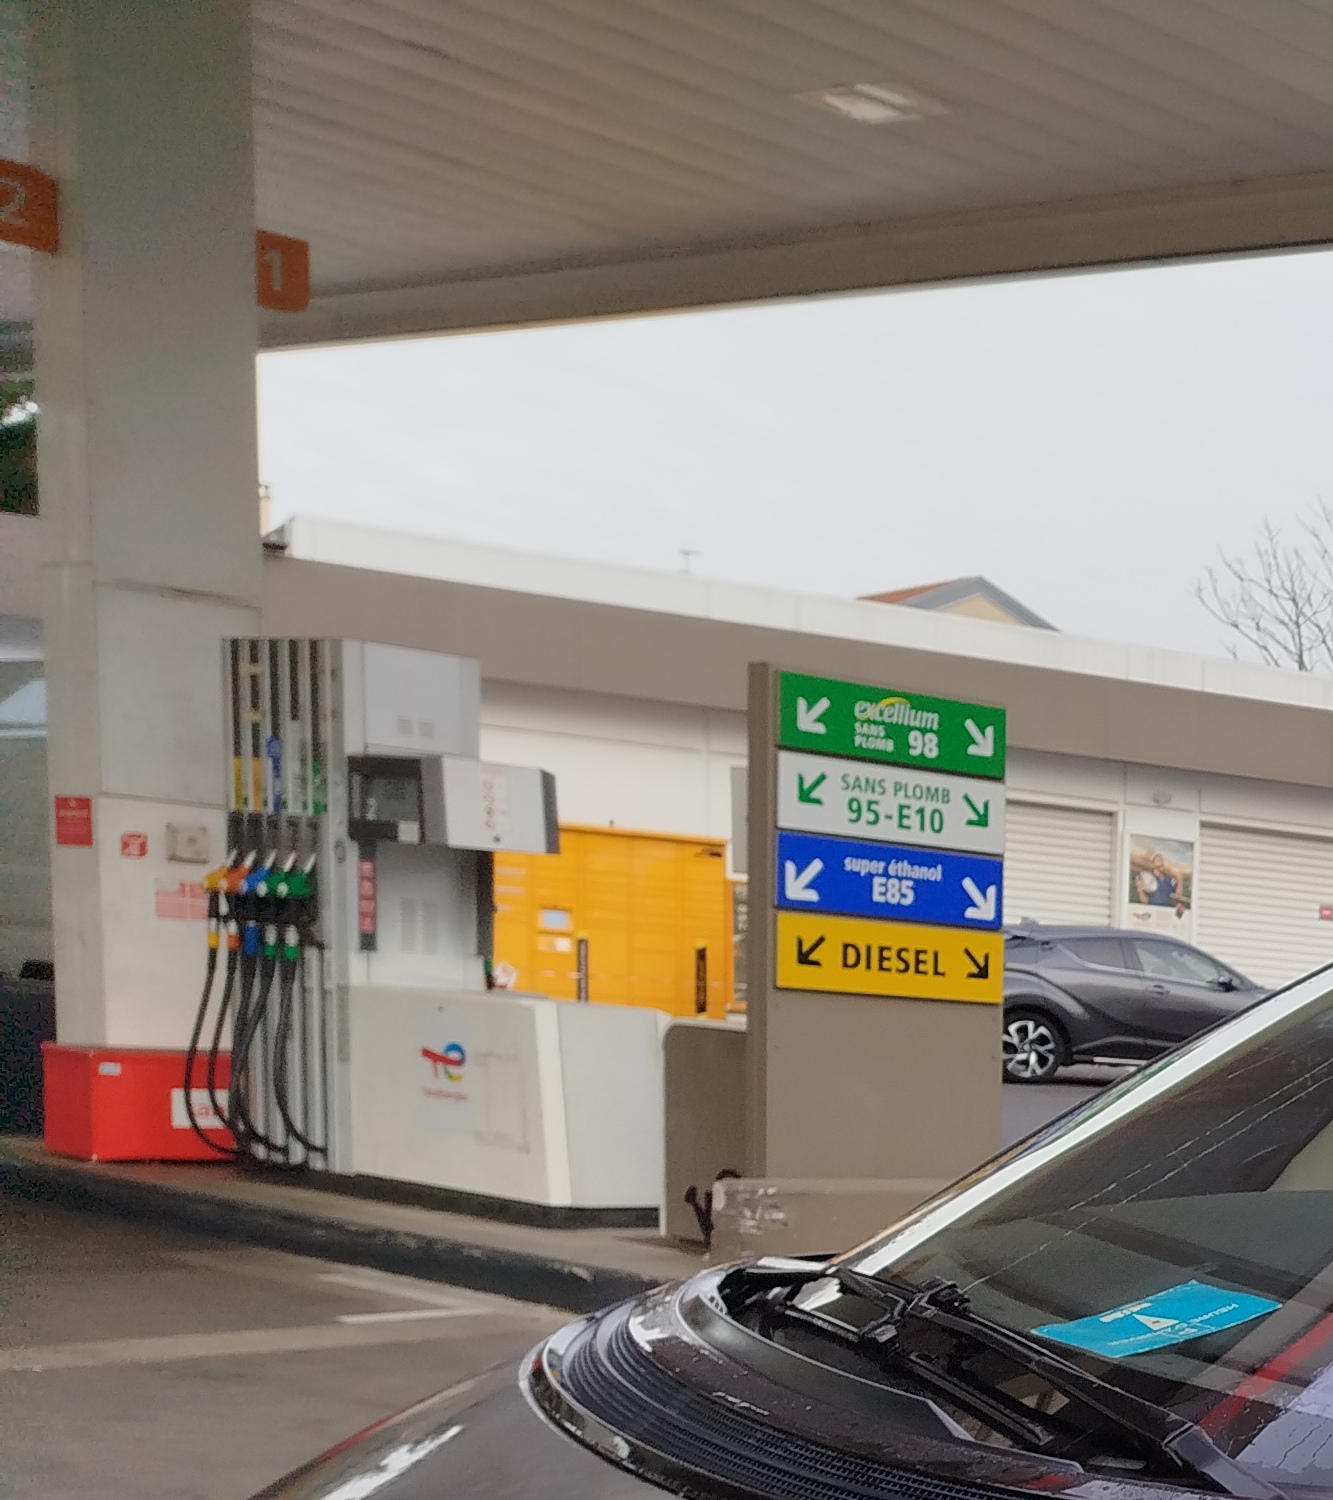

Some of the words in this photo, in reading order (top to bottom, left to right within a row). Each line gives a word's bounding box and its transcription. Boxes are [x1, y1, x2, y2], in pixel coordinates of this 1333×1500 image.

[0, 177, 26, 226] 2
[264, 250, 283, 291] 1
[854, 700, 939, 731] excellium
[854, 721, 886, 738] SANS
[854, 734, 895, 753] PLOMB
[907, 729, 939, 758] 98
[841, 773, 887, 796] SANS
[893, 781, 951, 804] PLOMB
[847, 797, 944, 834] 95-E10
[843, 856, 886, 877] super
[887, 859, 943, 882] éthanol
[871, 876, 915, 906] E85
[842, 943, 946, 977] DIESEL
